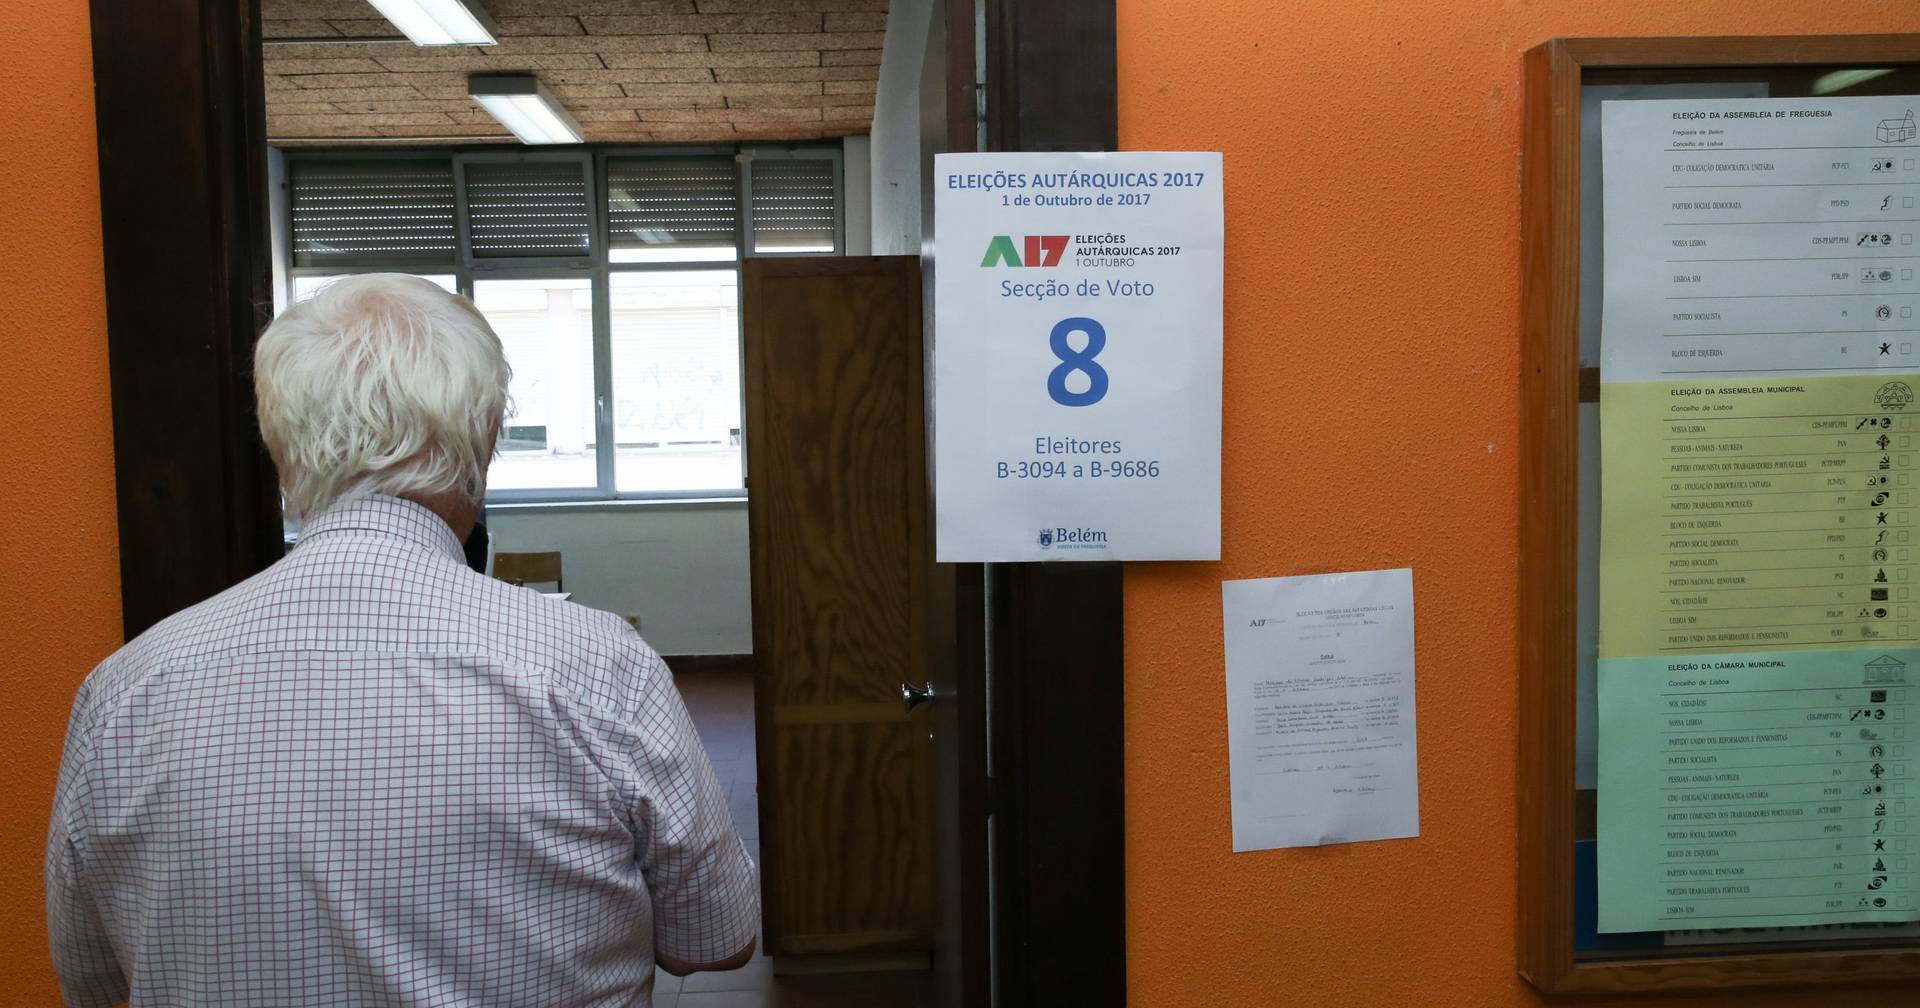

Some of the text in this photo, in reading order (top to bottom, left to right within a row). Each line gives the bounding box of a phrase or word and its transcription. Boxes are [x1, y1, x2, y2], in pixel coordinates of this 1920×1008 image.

[1672, 112, 1706, 120] ELEIÇÃO
[1723, 111, 1772, 119] ASSEMBLEIA
[1790, 110, 1832, 118] FREGUESIA
[948, 170, 1204, 191] ELEIÇÕES AUTÁRQUICAS 2017
[1002, 194, 1150, 206] 1 de Outubro de 2017
[1076, 233, 1125, 246] ELEIÇÕES
[1076, 244, 1180, 257] AUTÁRQUICAS 2017
[1076, 258, 1135, 267] 1 OUTUBRO
[1001, 280, 1154, 300] Secção de Voto
[1047, 317, 1109, 407] 8
[1671, 388, 1701, 396] ELEIÇÃO
[1036, 437, 1121, 454] Eleitores
[998, 461, 1159, 479] B-3094 a B-9686
[1056, 528, 1107, 542] Belém
[1668, 664, 1698, 672] ELEIÇÃO
